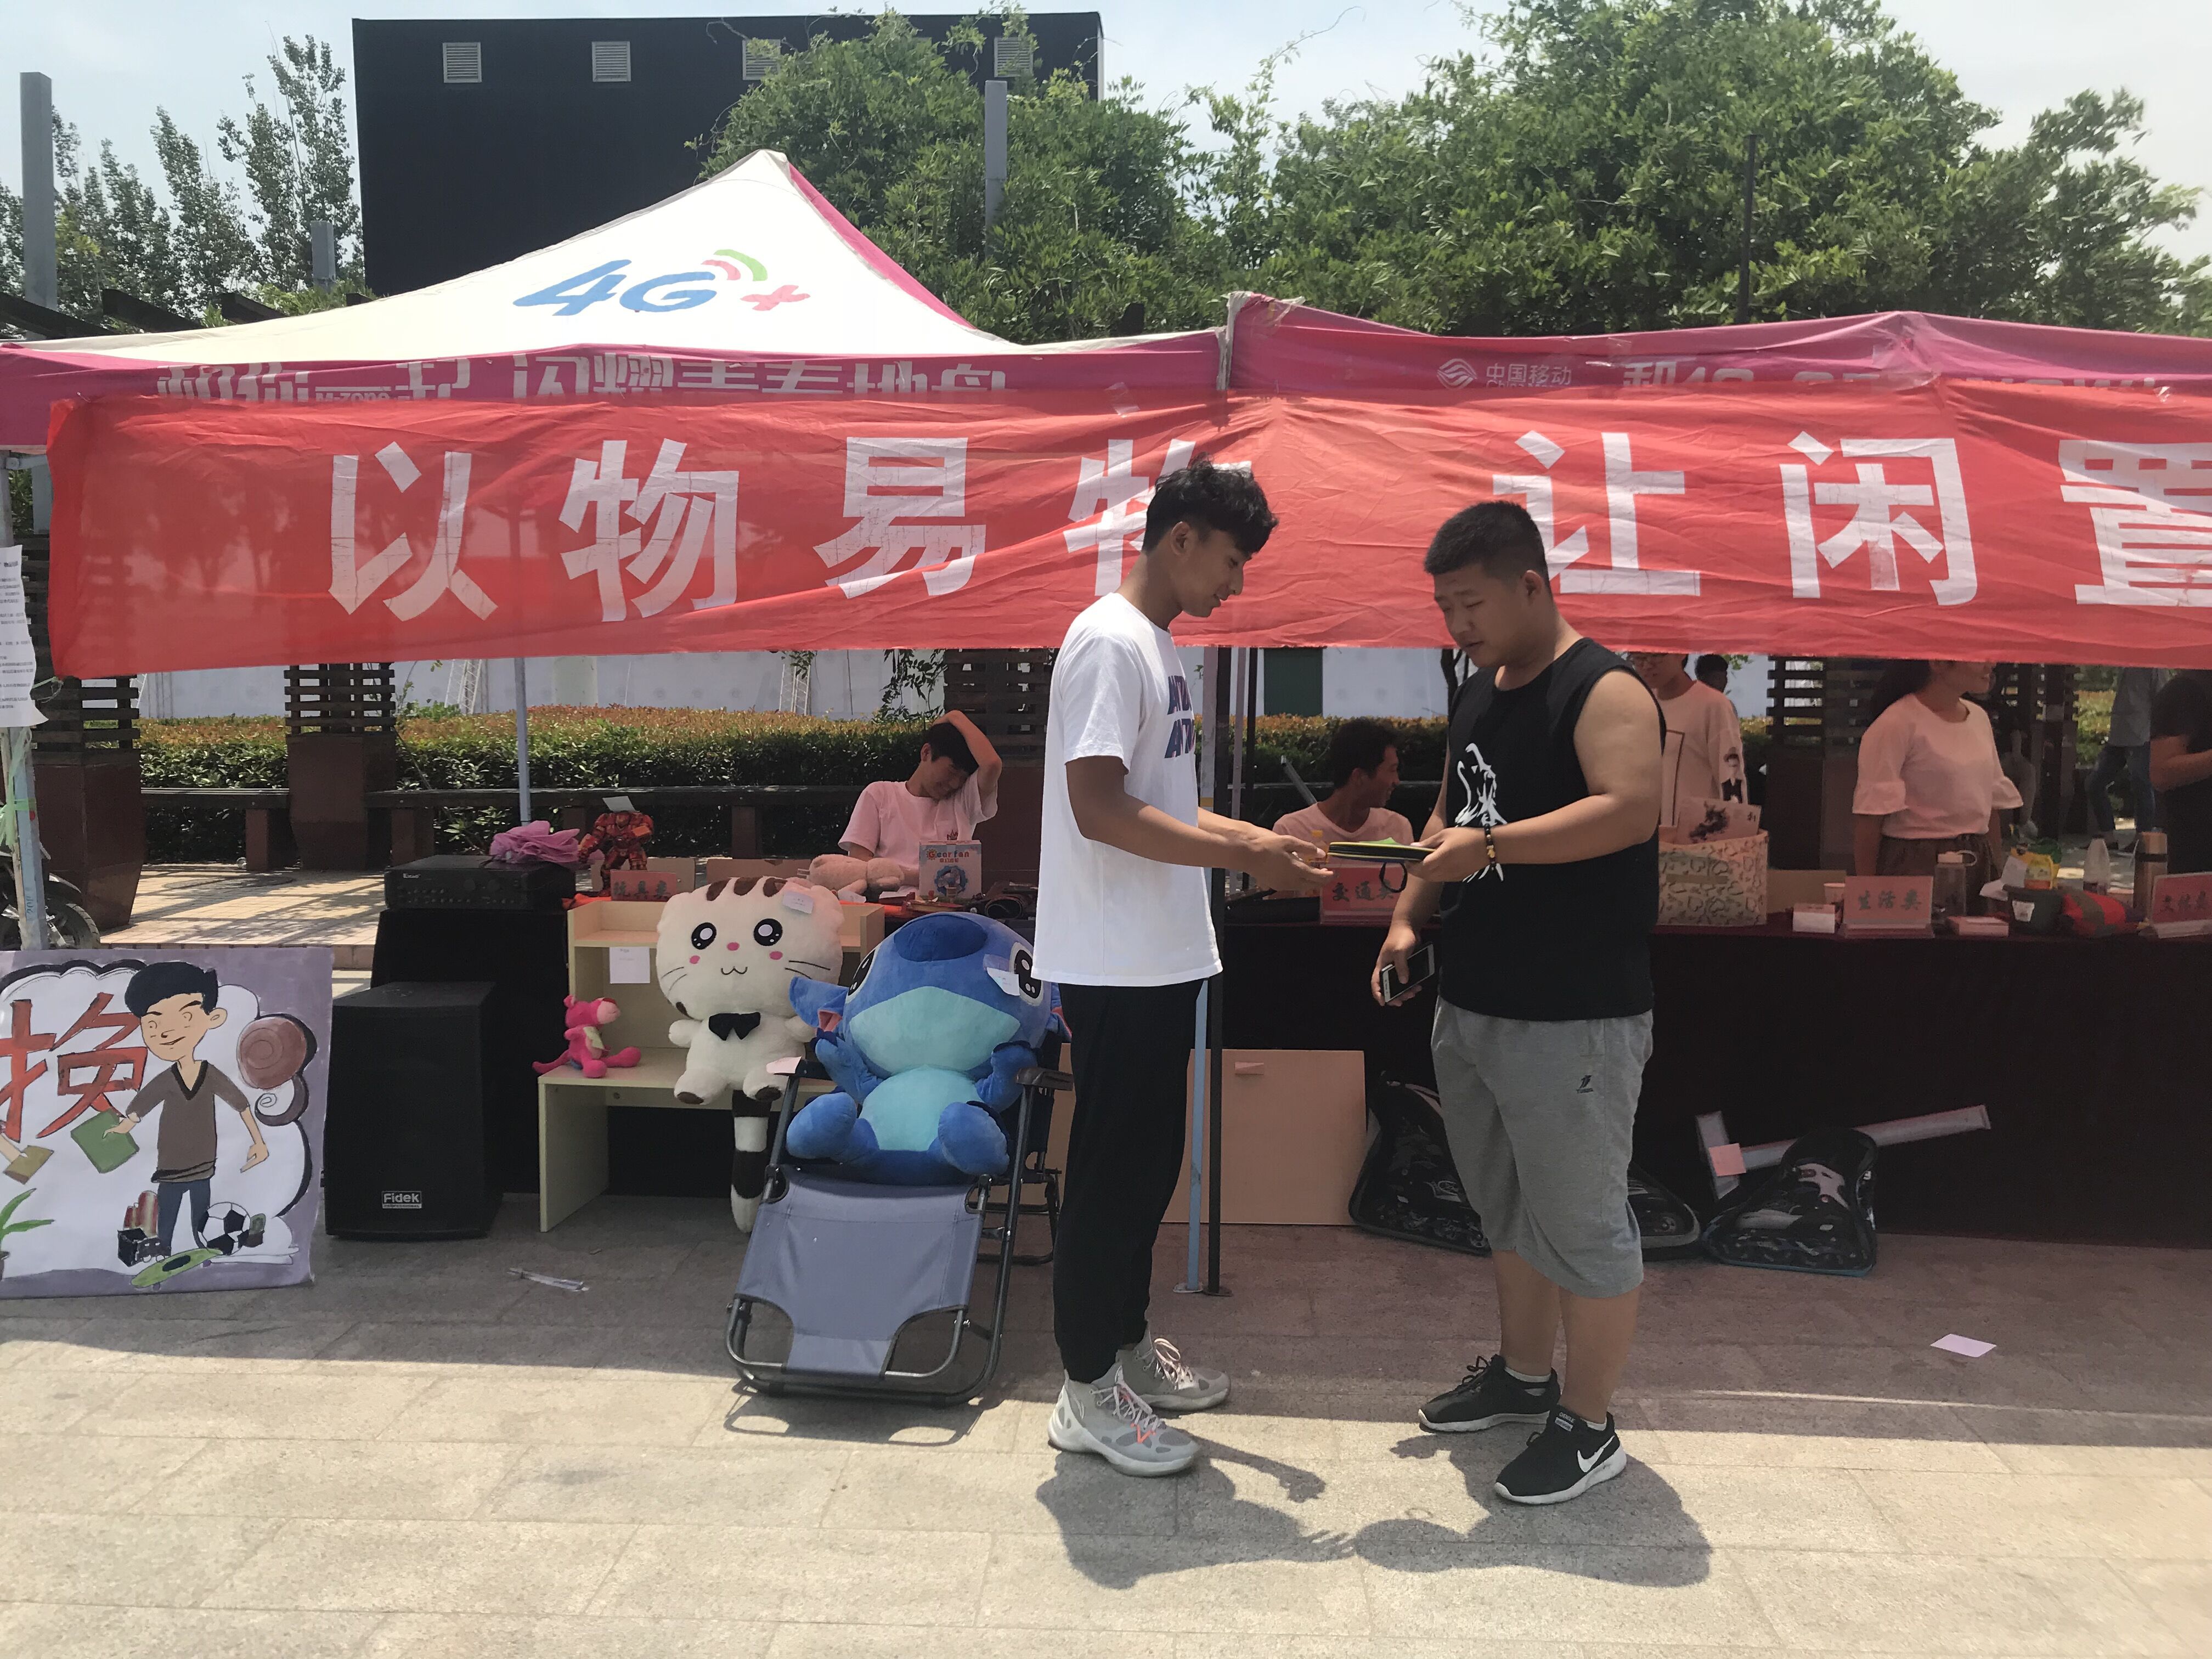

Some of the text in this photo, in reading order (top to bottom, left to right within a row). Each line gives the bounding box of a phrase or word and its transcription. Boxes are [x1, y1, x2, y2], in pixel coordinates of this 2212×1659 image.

[1486, 363, 1572, 385] 中国移动
[328, 430, 2212, 622] 以物易物 让闲置
[0, 992, 149, 1143] 换
[383, 1193, 420, 1203] Fidek
